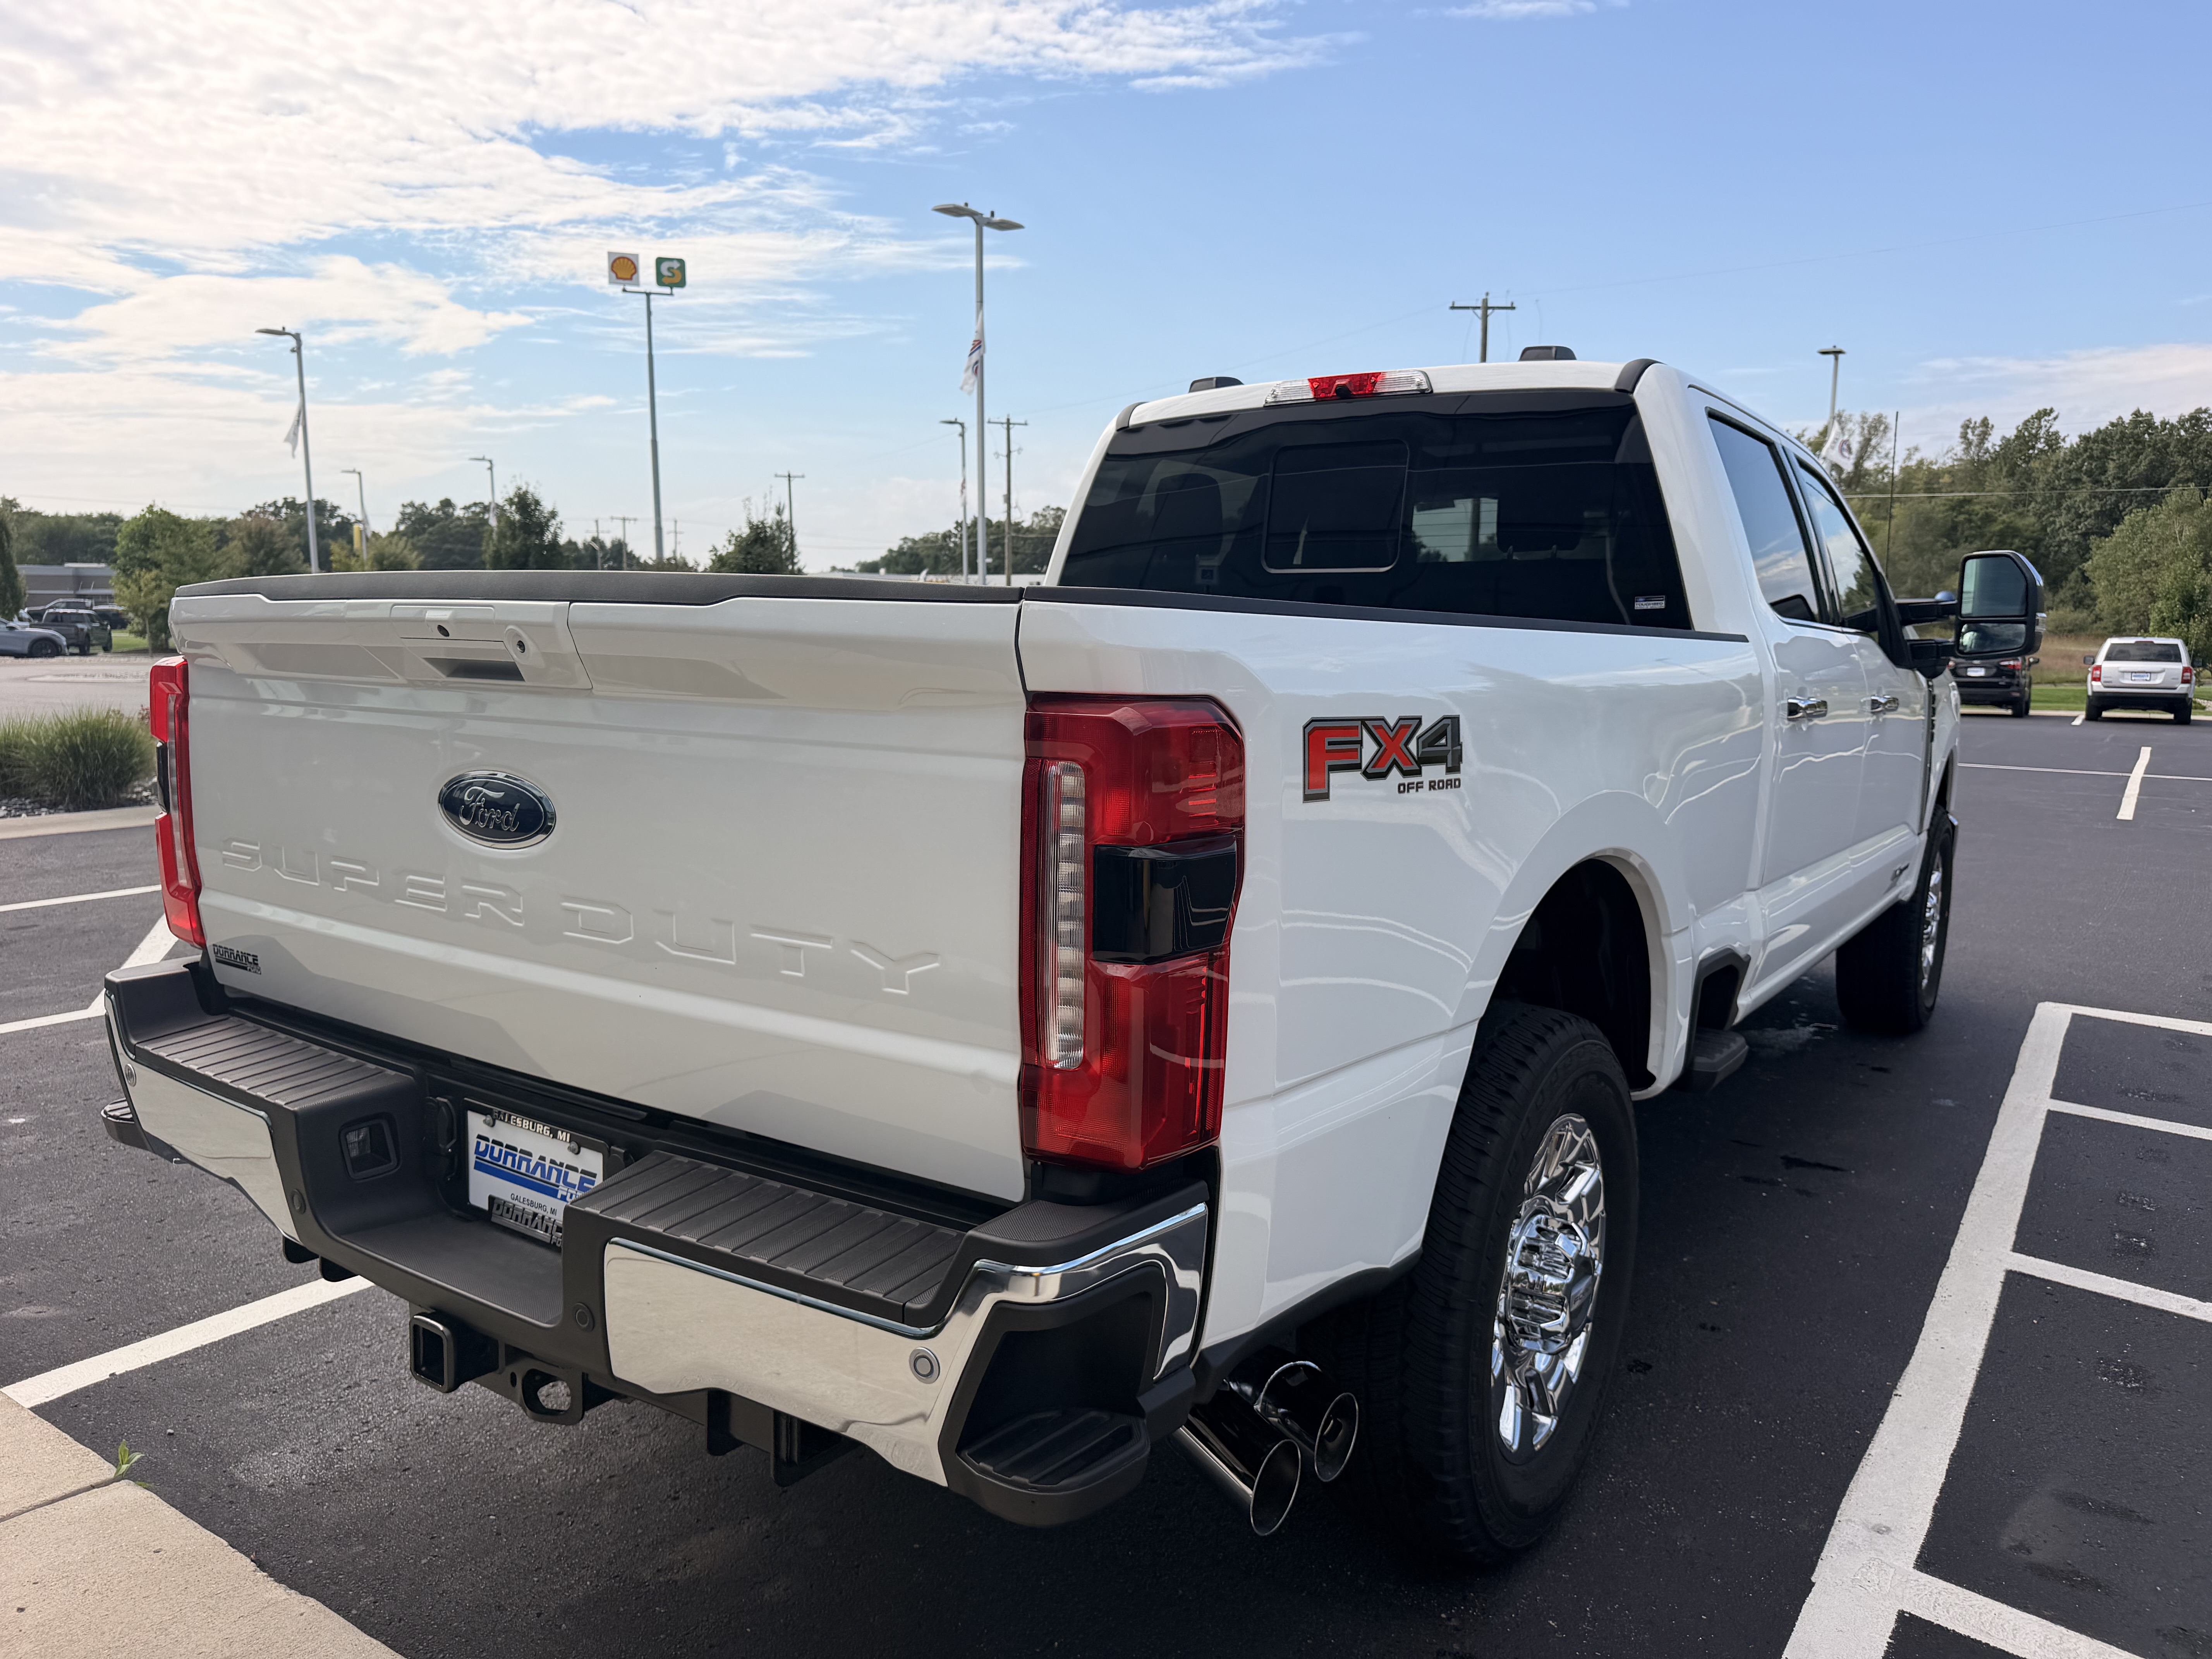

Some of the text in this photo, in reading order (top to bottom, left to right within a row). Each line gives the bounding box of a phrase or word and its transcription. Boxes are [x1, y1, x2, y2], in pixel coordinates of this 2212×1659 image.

[1302, 714, 1463, 803] FX4
[1397, 778, 1461, 794] OFF ROAD
[459, 786, 520, 832] Ford
[222, 836, 941, 995] SUPER DUTY
[556, 1130, 571, 1142] MI
[492, 1199, 563, 1236] DORRANC
[510, 1193, 557, 1216] GALESBURG, MI
[551, 1235, 562, 1247] FO
